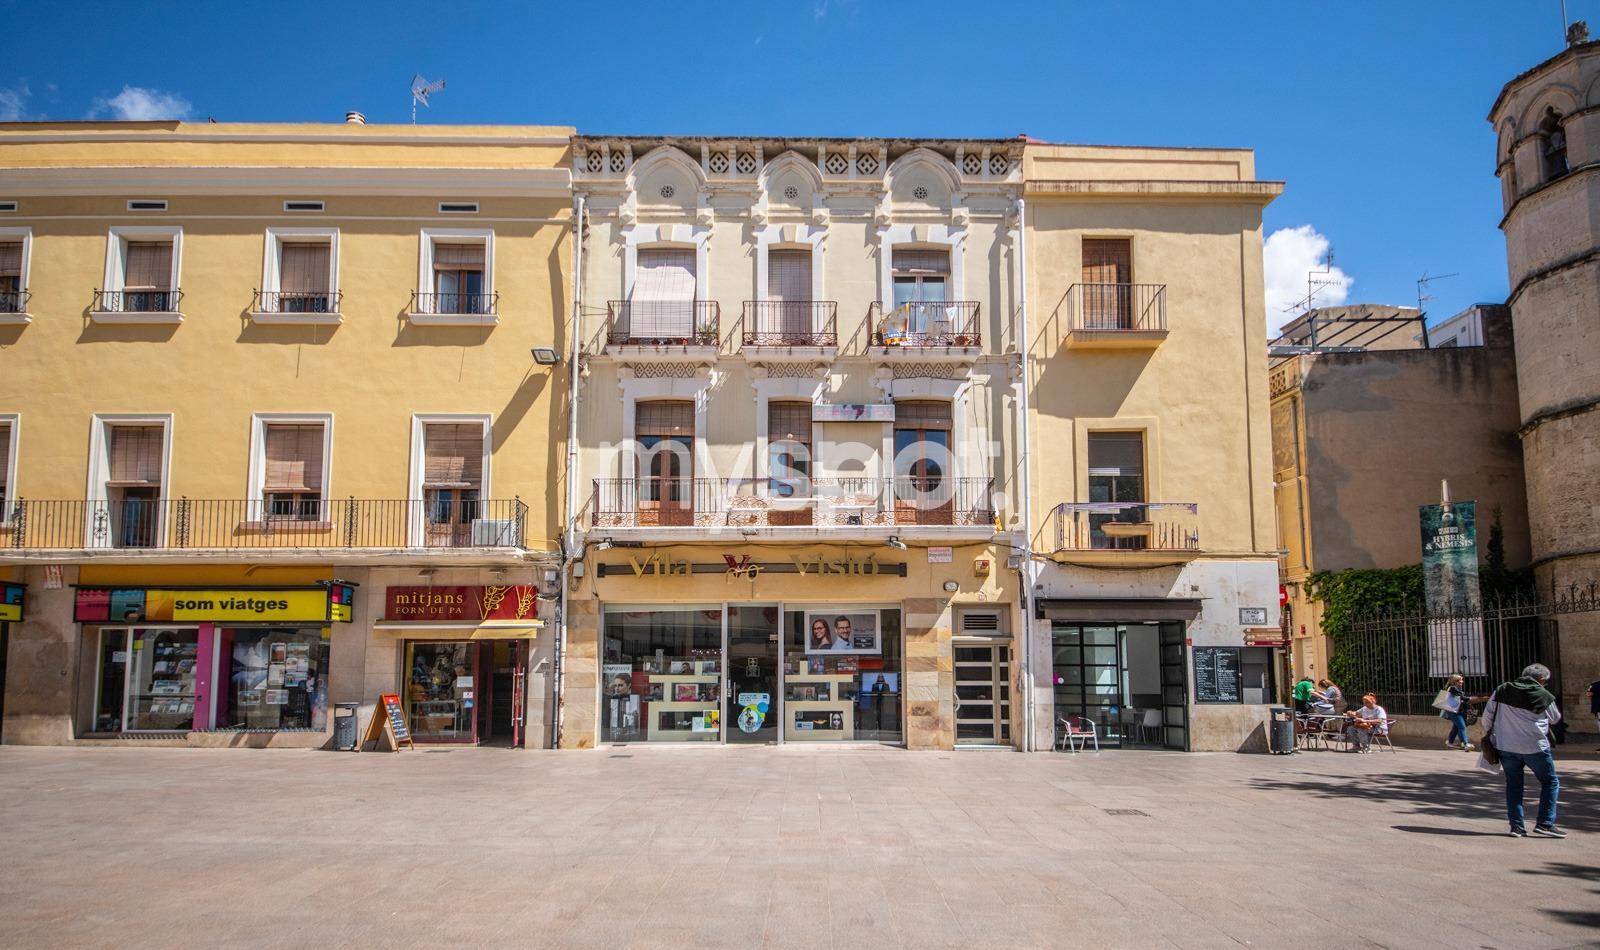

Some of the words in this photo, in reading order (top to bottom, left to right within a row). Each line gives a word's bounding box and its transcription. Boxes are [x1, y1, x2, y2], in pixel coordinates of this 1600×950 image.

[1433, 533, 1465, 543] HYBRIS
[1435, 539, 1474, 549] NEMESIS
[630, 553, 692, 578] Vila
[789, 552, 879, 577] Visió
[174, 599, 214, 610] som
[218, 597, 289, 613] viatges
[395, 591, 464, 607] mitjans
[395, 606, 425, 615] FORN
[430, 606, 444, 614] DE
[449, 606, 462, 614] PA
